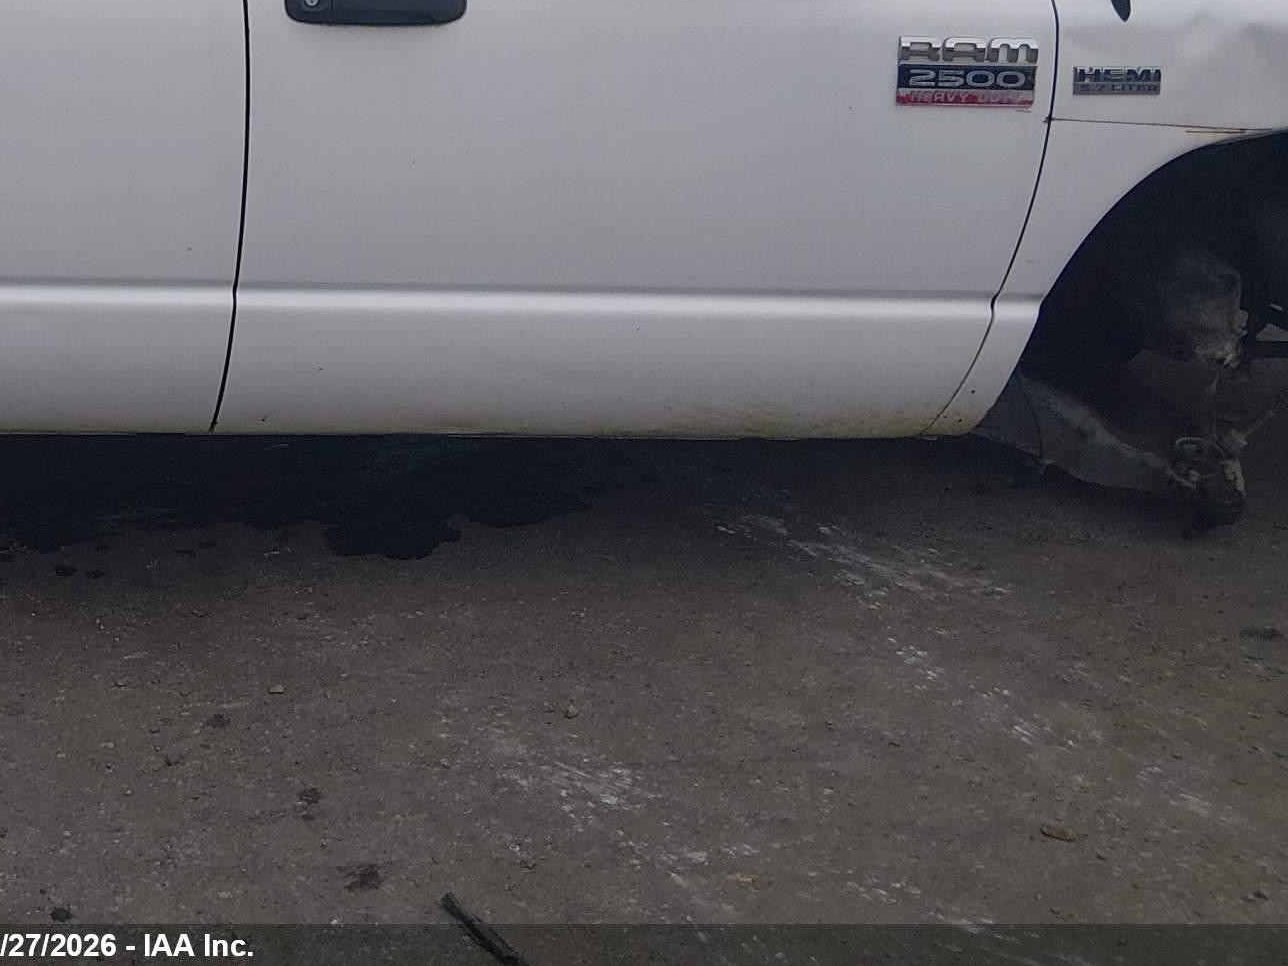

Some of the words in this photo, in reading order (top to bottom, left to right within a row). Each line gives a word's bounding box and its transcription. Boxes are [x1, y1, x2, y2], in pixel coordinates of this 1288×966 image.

[899, 36, 1039, 63] RAM
[909, 69, 1026, 88] 2500
[1074, 66, 1161, 83] HEMI
[1110, 83, 1159, 92] LITER
[909, 90, 972, 105] HEAVY
